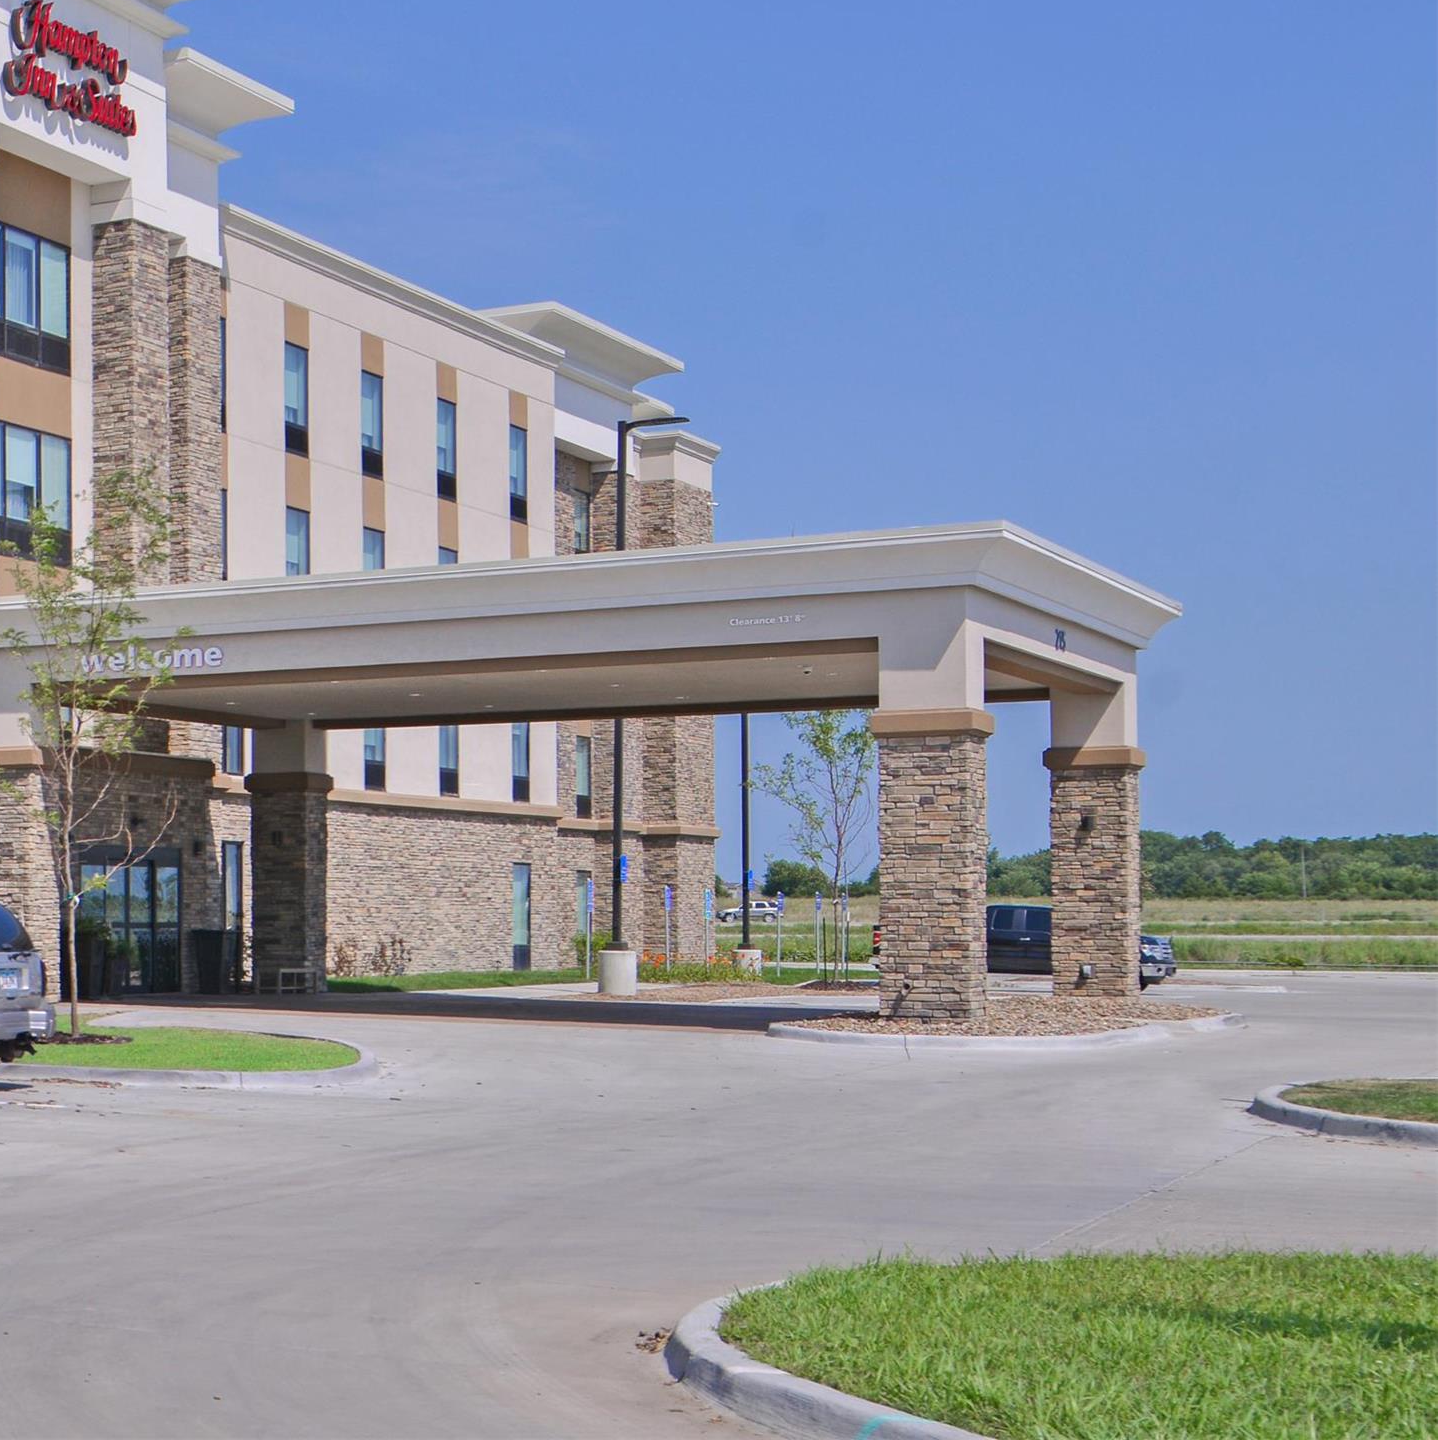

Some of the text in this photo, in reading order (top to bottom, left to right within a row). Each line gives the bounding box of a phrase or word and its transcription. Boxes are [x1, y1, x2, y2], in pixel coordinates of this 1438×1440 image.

[10, 0, 129, 86] Hampton
[2, 53, 66, 111] Inn
[79, 78, 137, 137] Suites
[729, 617, 776, 627] Clearance
